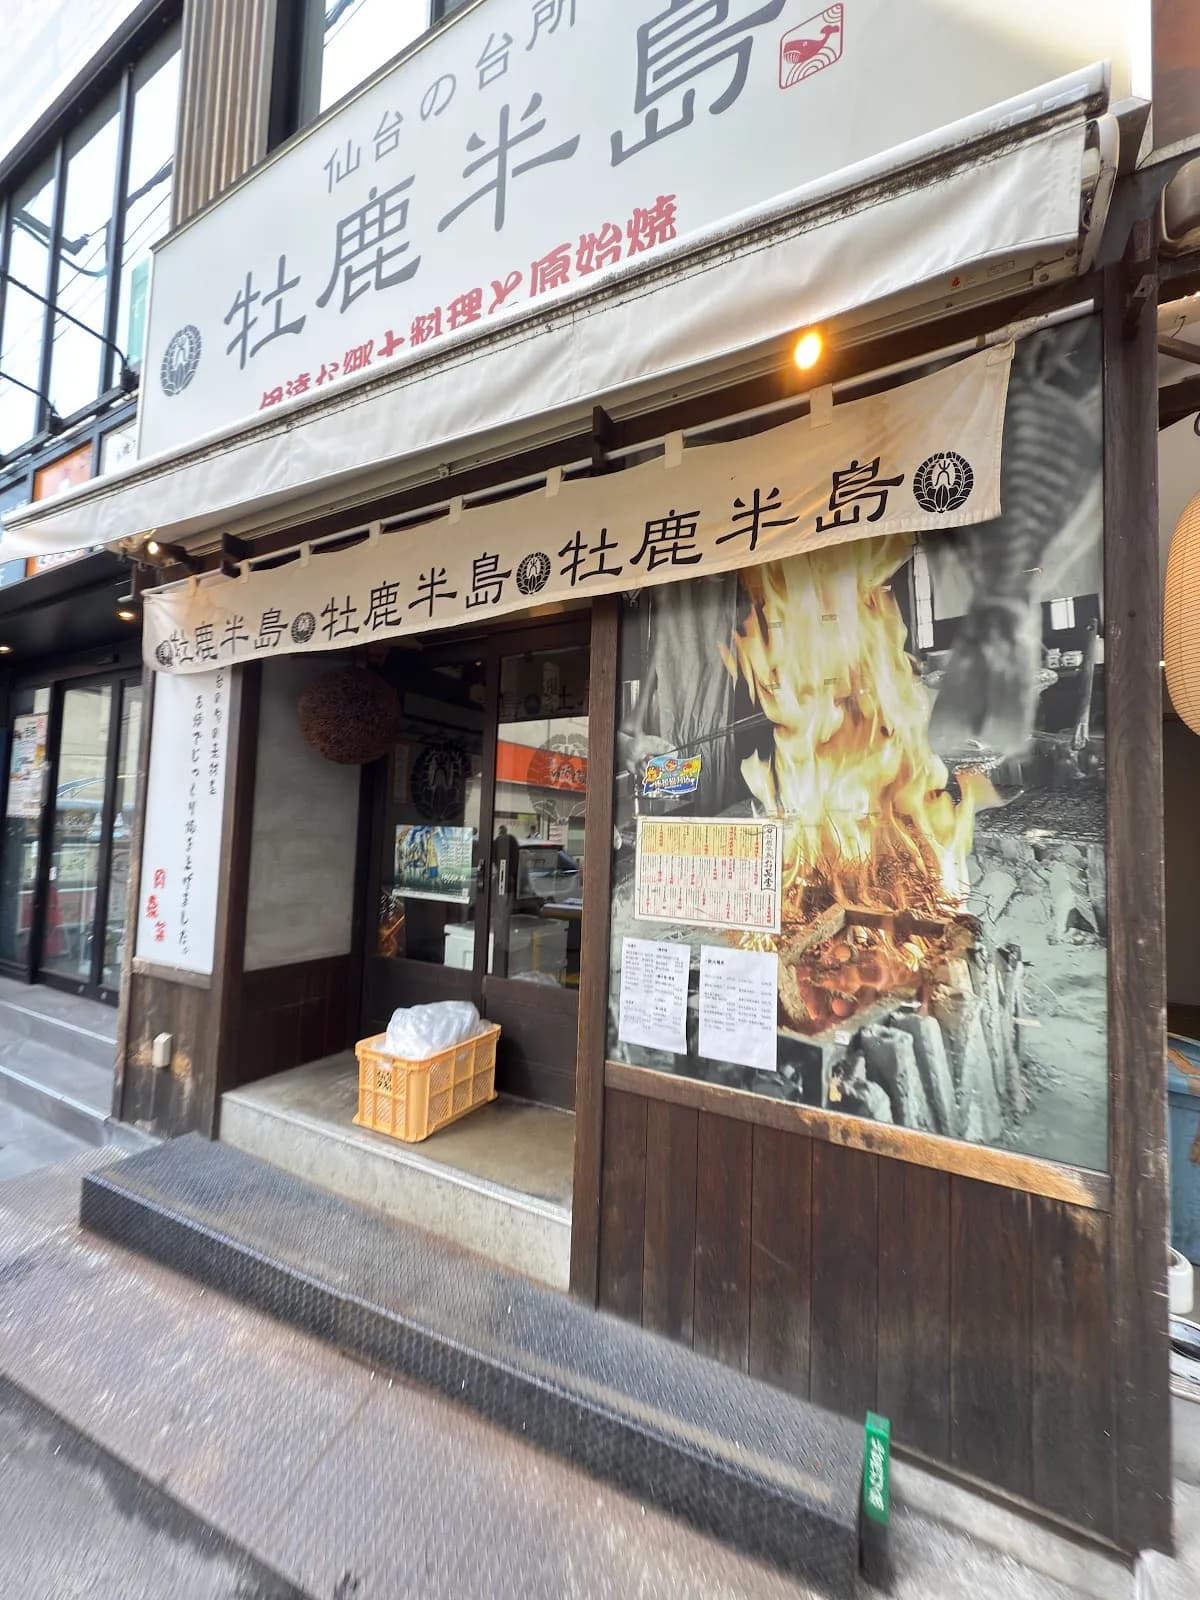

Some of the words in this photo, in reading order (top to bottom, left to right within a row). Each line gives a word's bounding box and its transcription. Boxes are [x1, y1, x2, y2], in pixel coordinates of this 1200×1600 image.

[223, 0, 788, 371] 牡鹿半島
[169, 606, 289, 666] 牡鹿半島
[320, 550, 512, 642] 牡鹿半島
[556, 455, 906, 587] 牡鹿半島
